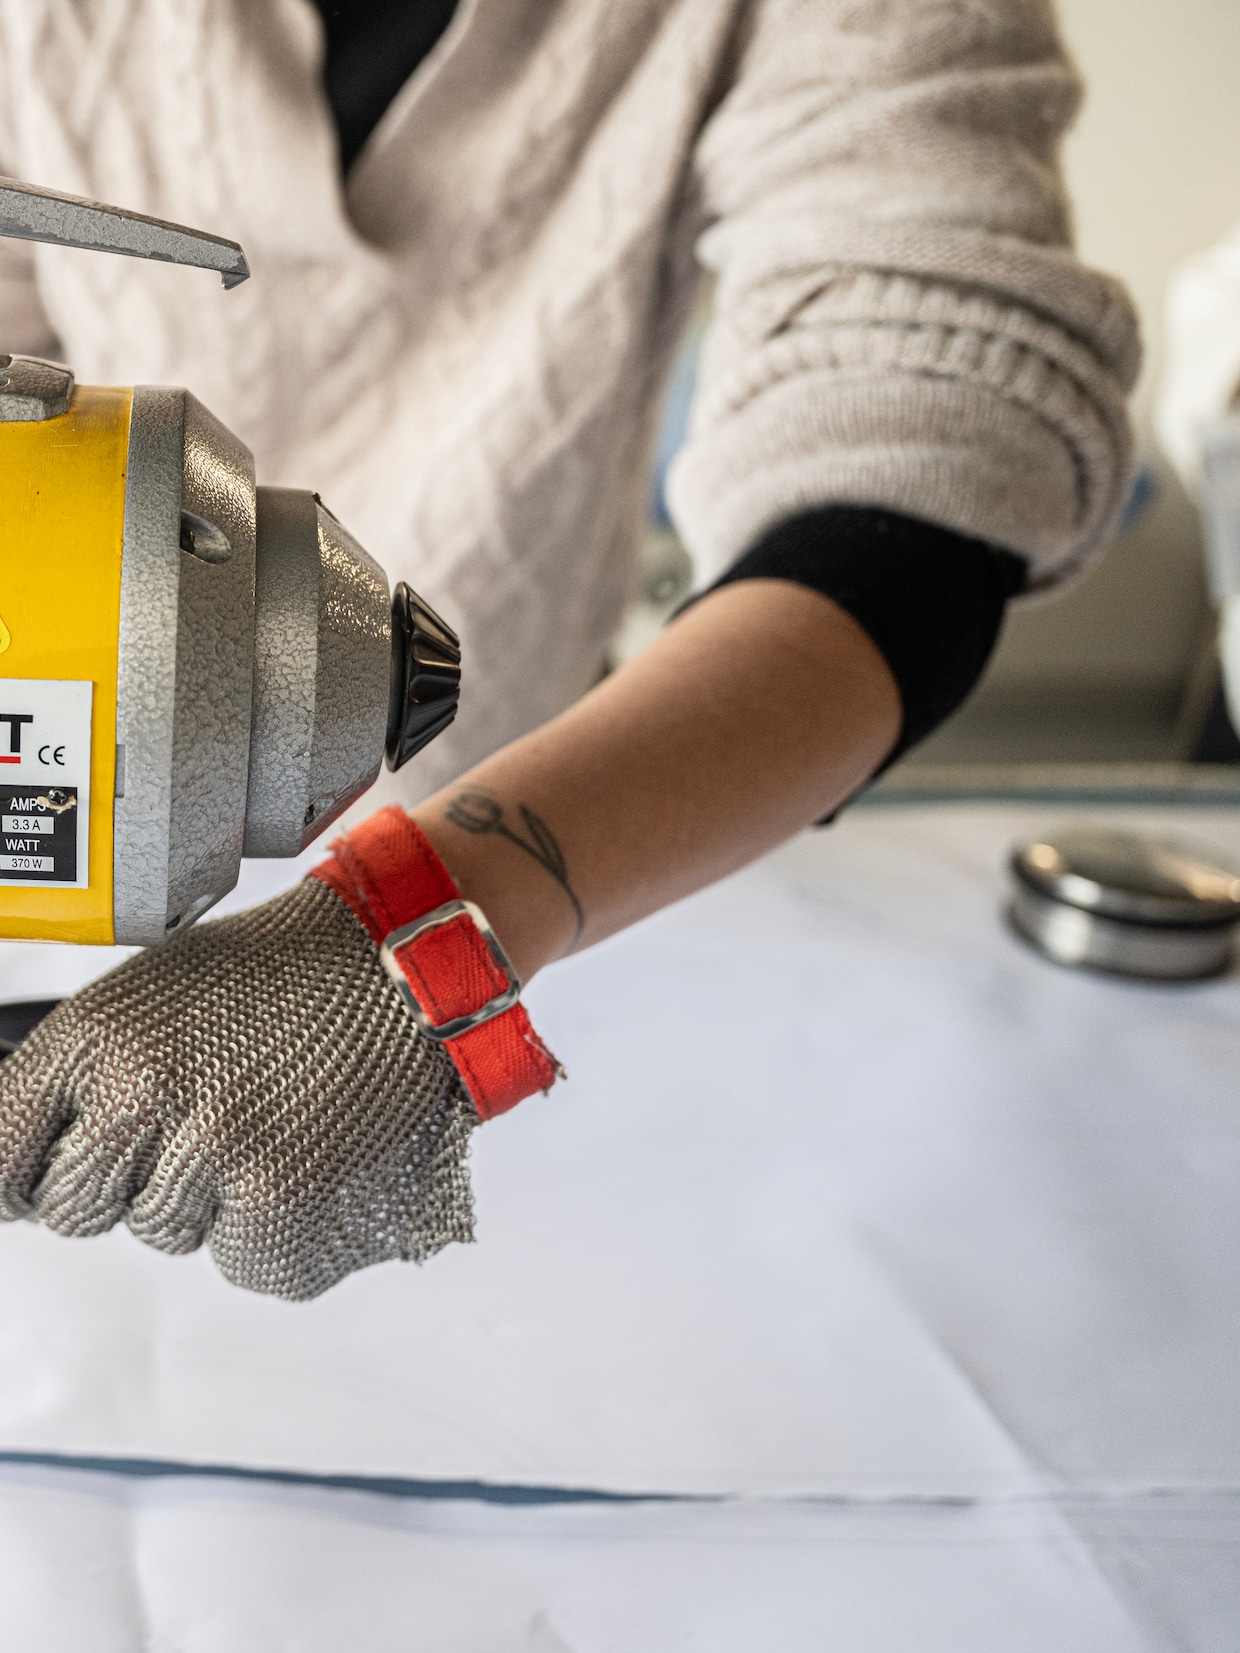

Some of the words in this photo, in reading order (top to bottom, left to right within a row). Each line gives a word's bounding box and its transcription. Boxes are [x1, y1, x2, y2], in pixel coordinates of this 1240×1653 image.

[12, 819, 29, 830] 3.3
[32, 820, 40, 830] A
[5, 839, 40, 852] WATT
[12, 858, 30, 868] 370
[32, 859, 43, 868] W
